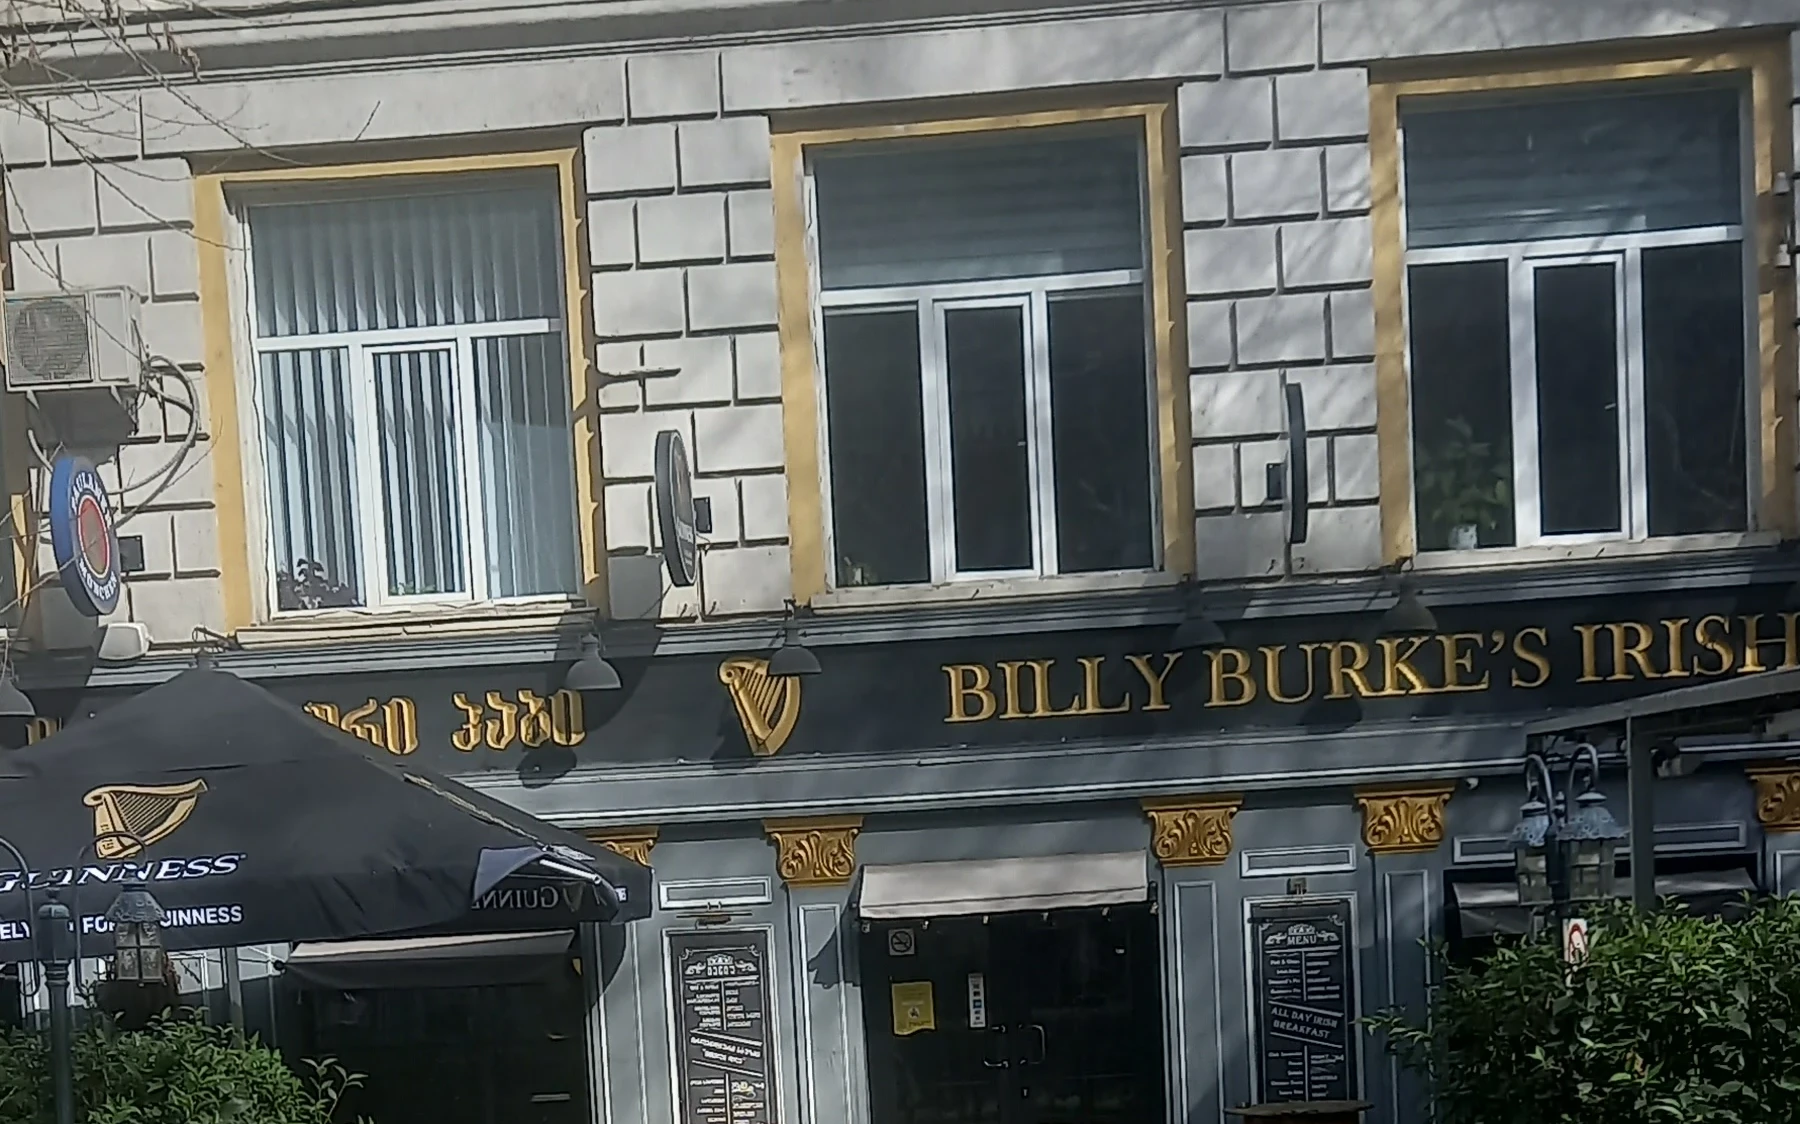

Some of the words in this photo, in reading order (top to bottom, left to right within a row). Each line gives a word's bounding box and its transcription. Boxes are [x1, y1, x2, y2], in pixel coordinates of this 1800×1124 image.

[941, 651, 1183, 723] BILLY
[1573, 612, 1800, 683] IRISH
[452, 689, 585, 751] პაბი
[160, 906, 243, 927] UINNESS
[1271, 1007, 1290, 1018] ALL
[1291, 1011, 1313, 1022] DAY
[1273, 1020, 1331, 1039] BREAKFAST
